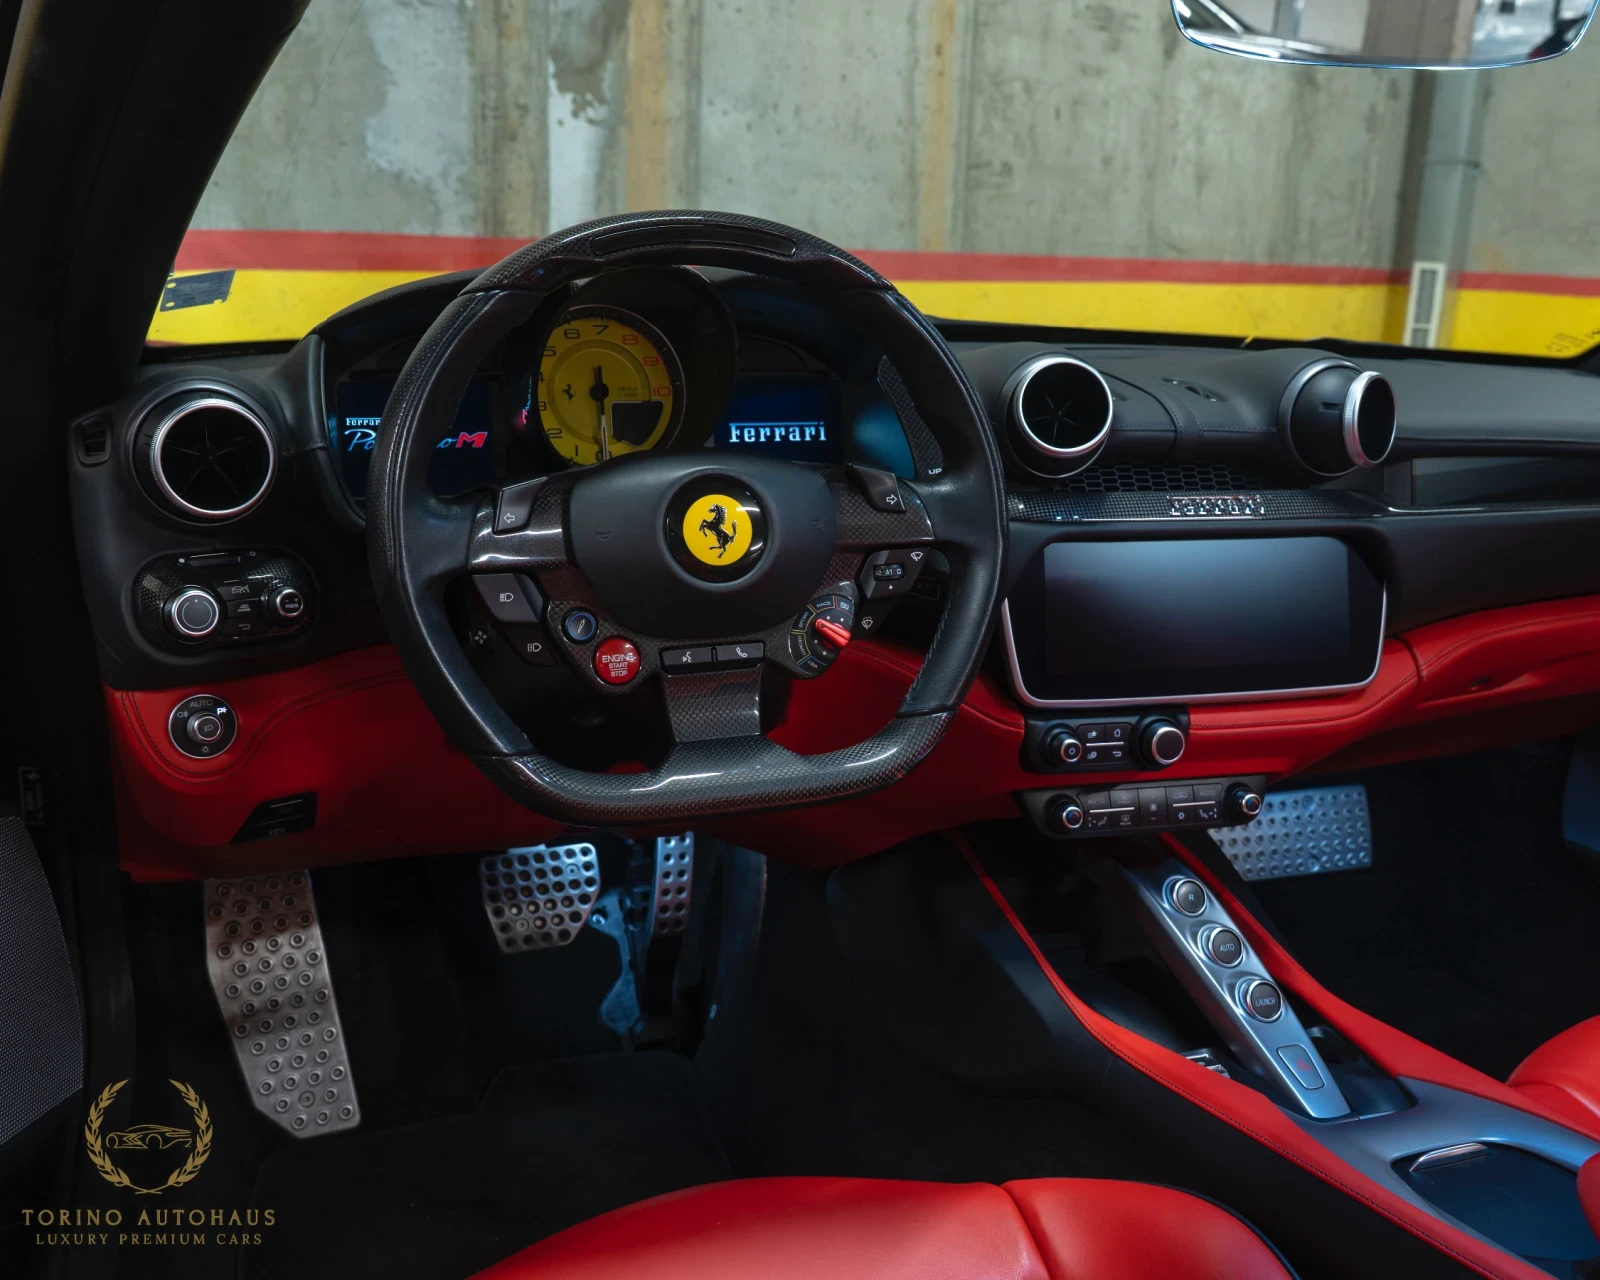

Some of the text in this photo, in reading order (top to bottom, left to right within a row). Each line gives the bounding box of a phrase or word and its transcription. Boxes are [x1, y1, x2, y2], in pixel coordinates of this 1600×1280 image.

[564, 328, 580, 339] 6
[592, 325, 609, 335] 7
[622, 334, 639, 345] 8
[543, 346, 556, 357] 5
[643, 356, 659, 366] 9
[653, 386, 671, 397] 10
[346, 417, 381, 426] Ferrar
[547, 428, 563, 438] 2
[729, 421, 827, 443] Ferrari
[928, 467, 942, 475] UP
[602, 652, 636, 662] ENGINE
[608, 661, 628, 669] START
[190, 700, 213, 708] AUTO
[1219, 943, 1235, 952] AUTO
[1255, 997, 1276, 1007] LAUNCH
